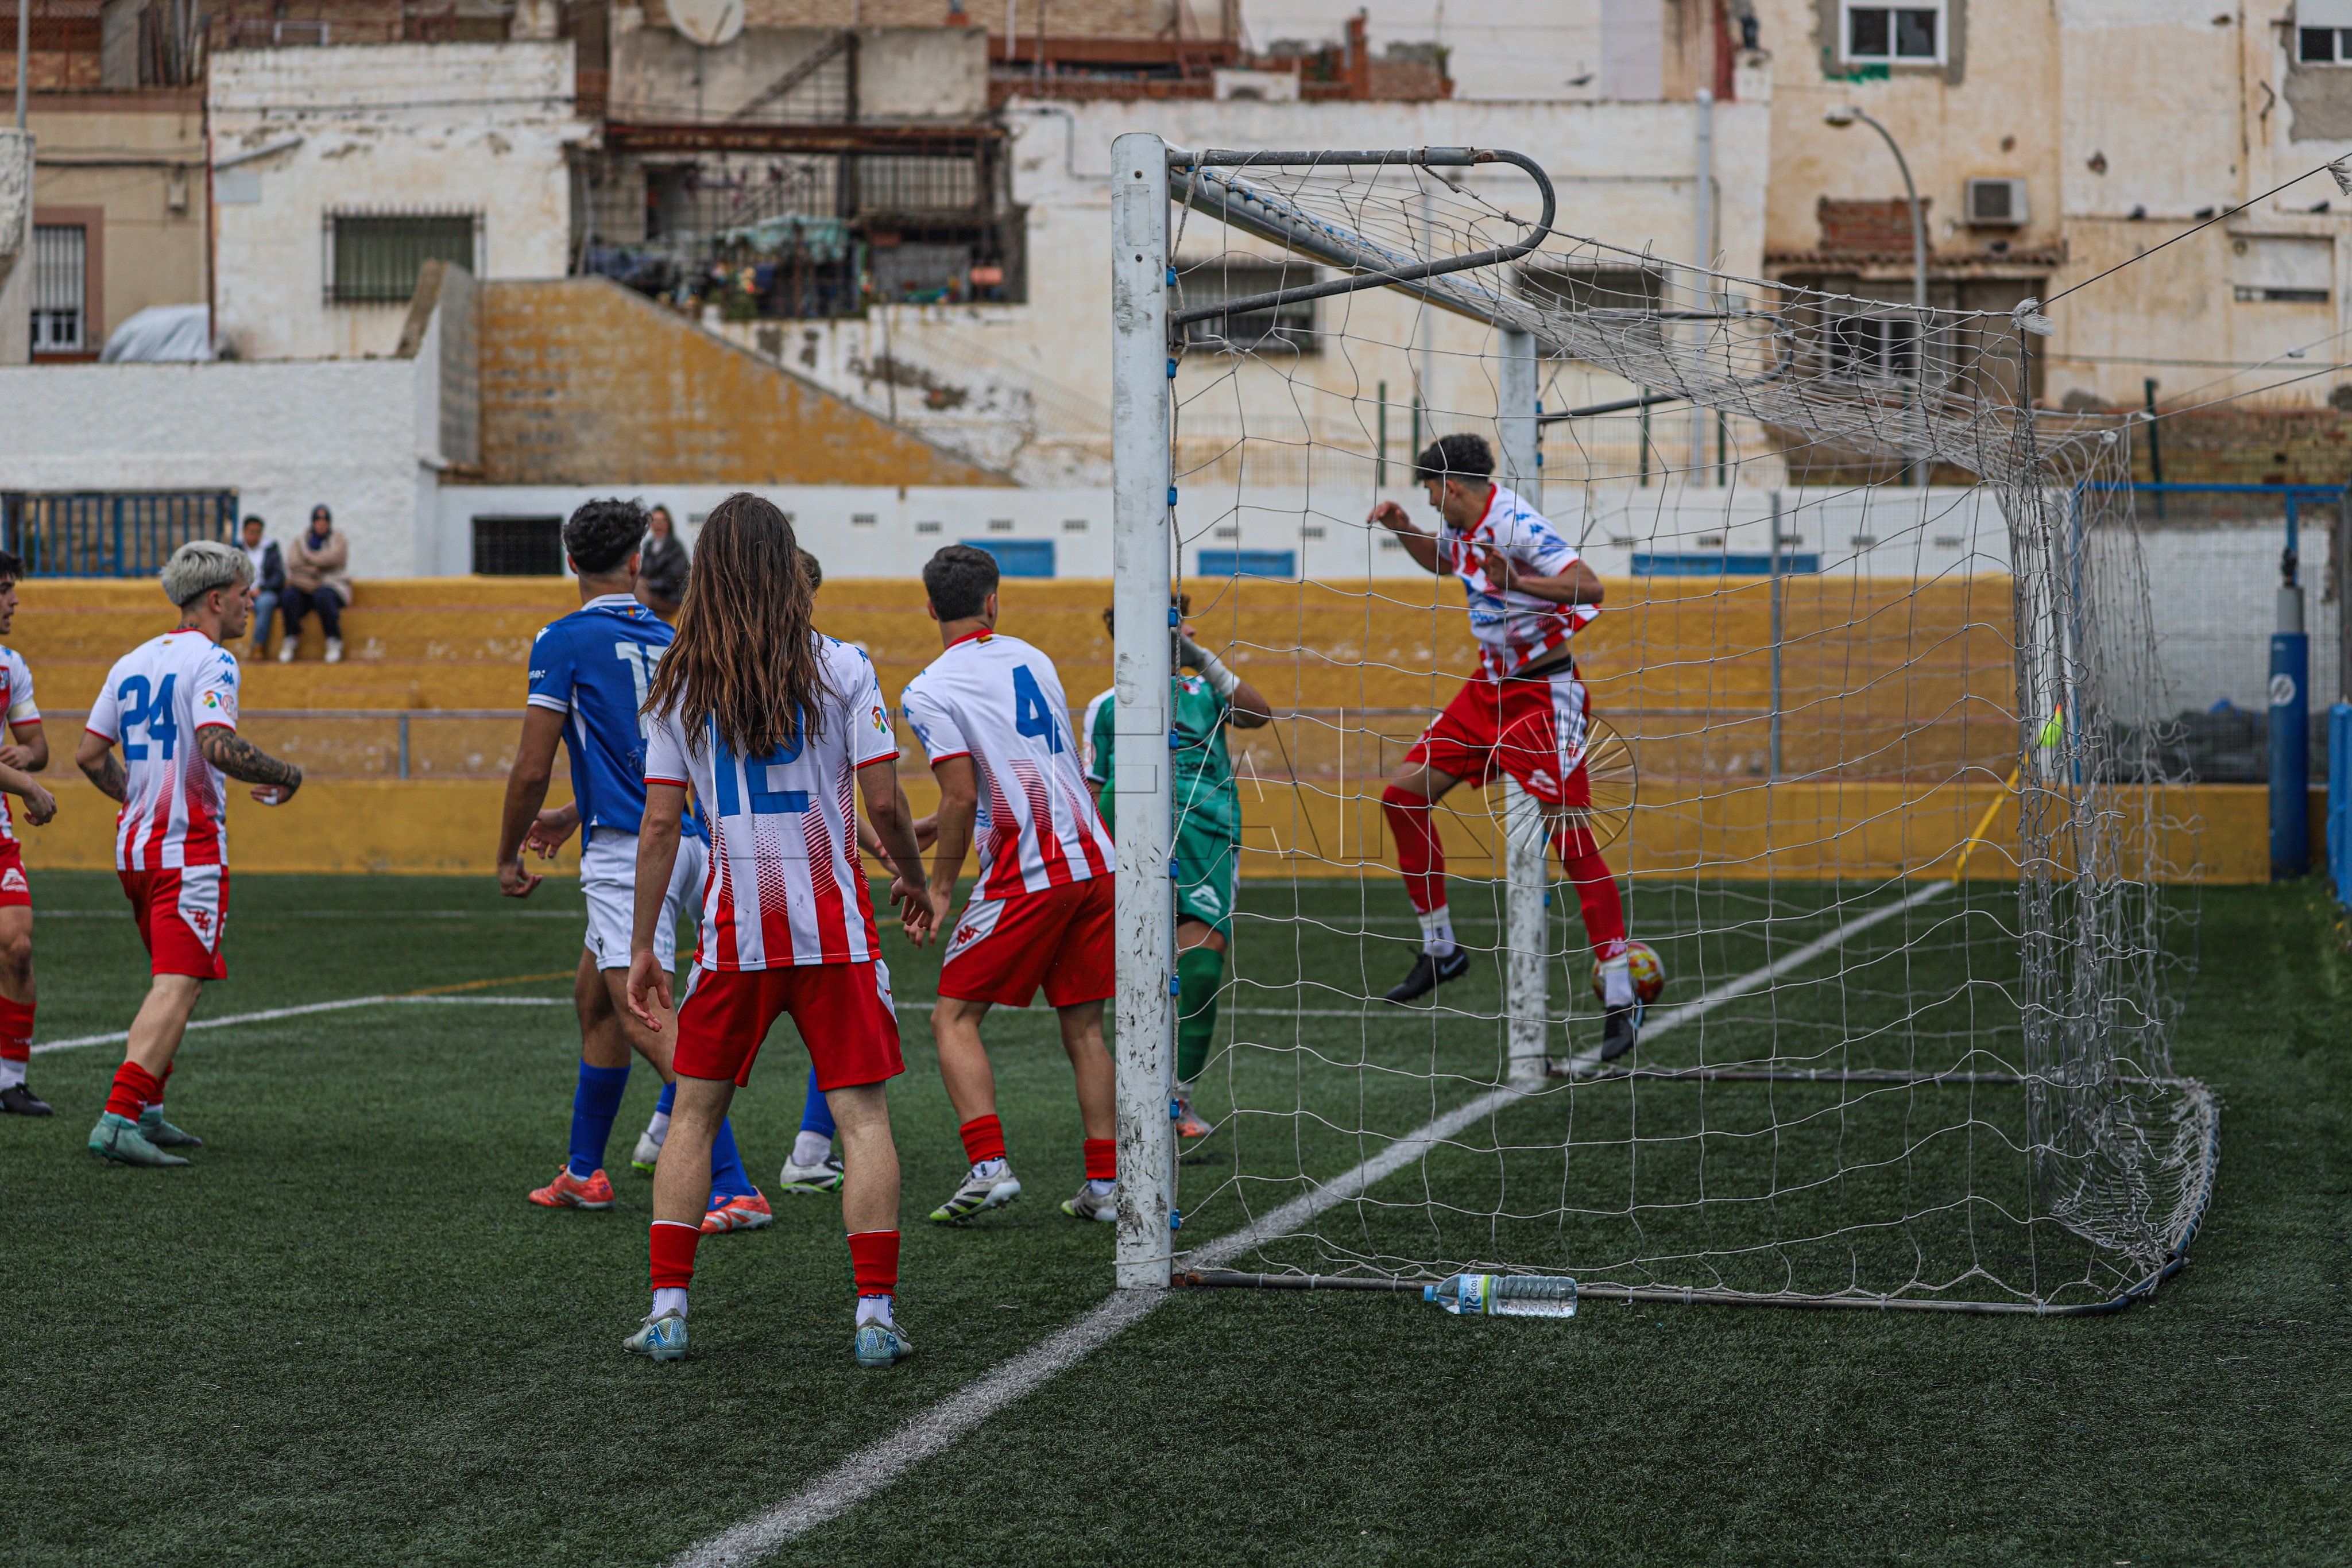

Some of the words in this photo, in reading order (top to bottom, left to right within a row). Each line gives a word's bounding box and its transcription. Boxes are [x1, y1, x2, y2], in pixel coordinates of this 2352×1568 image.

[118, 673, 177, 761] 24
[1012, 664, 1064, 754] 4
[705, 701, 810, 817] 12
